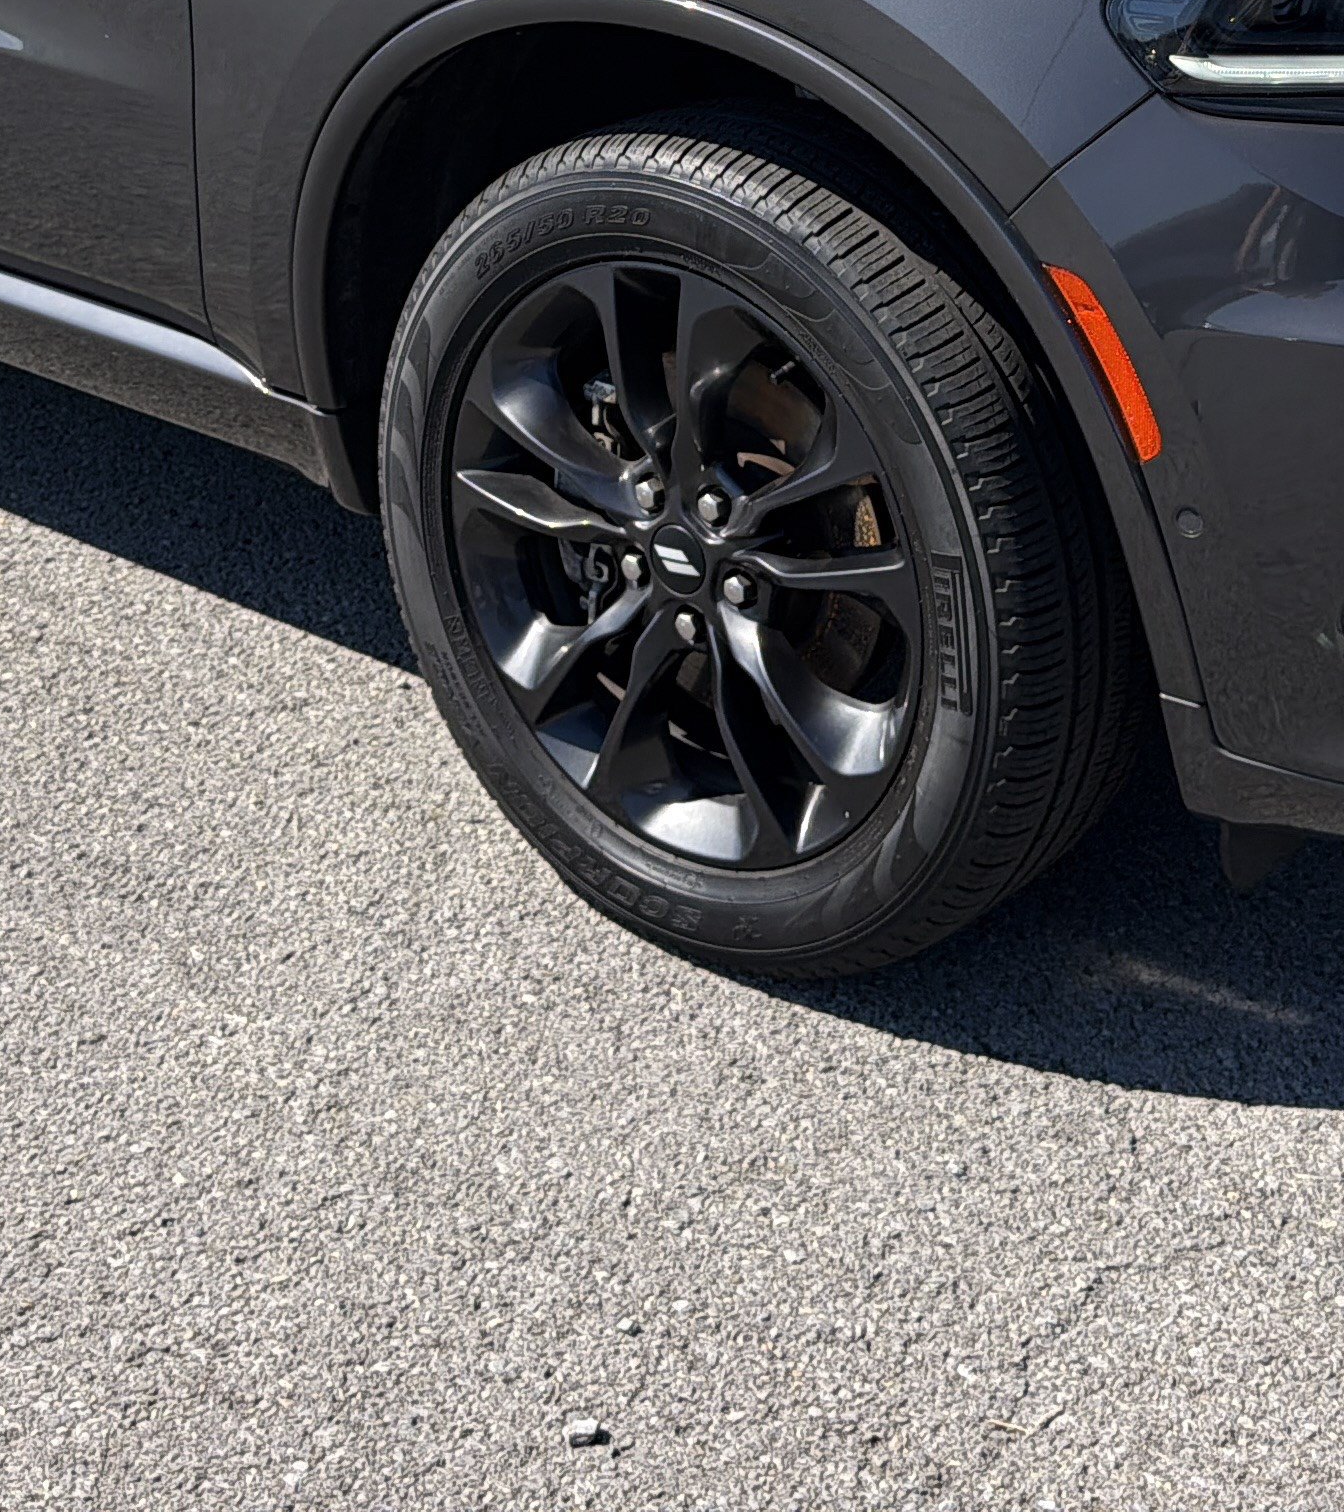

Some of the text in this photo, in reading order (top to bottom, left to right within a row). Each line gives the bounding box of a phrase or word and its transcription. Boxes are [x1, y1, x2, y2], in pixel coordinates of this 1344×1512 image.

[474, 204, 651, 280] 265/50 R20
[930, 549, 973, 716] PIRELLI
